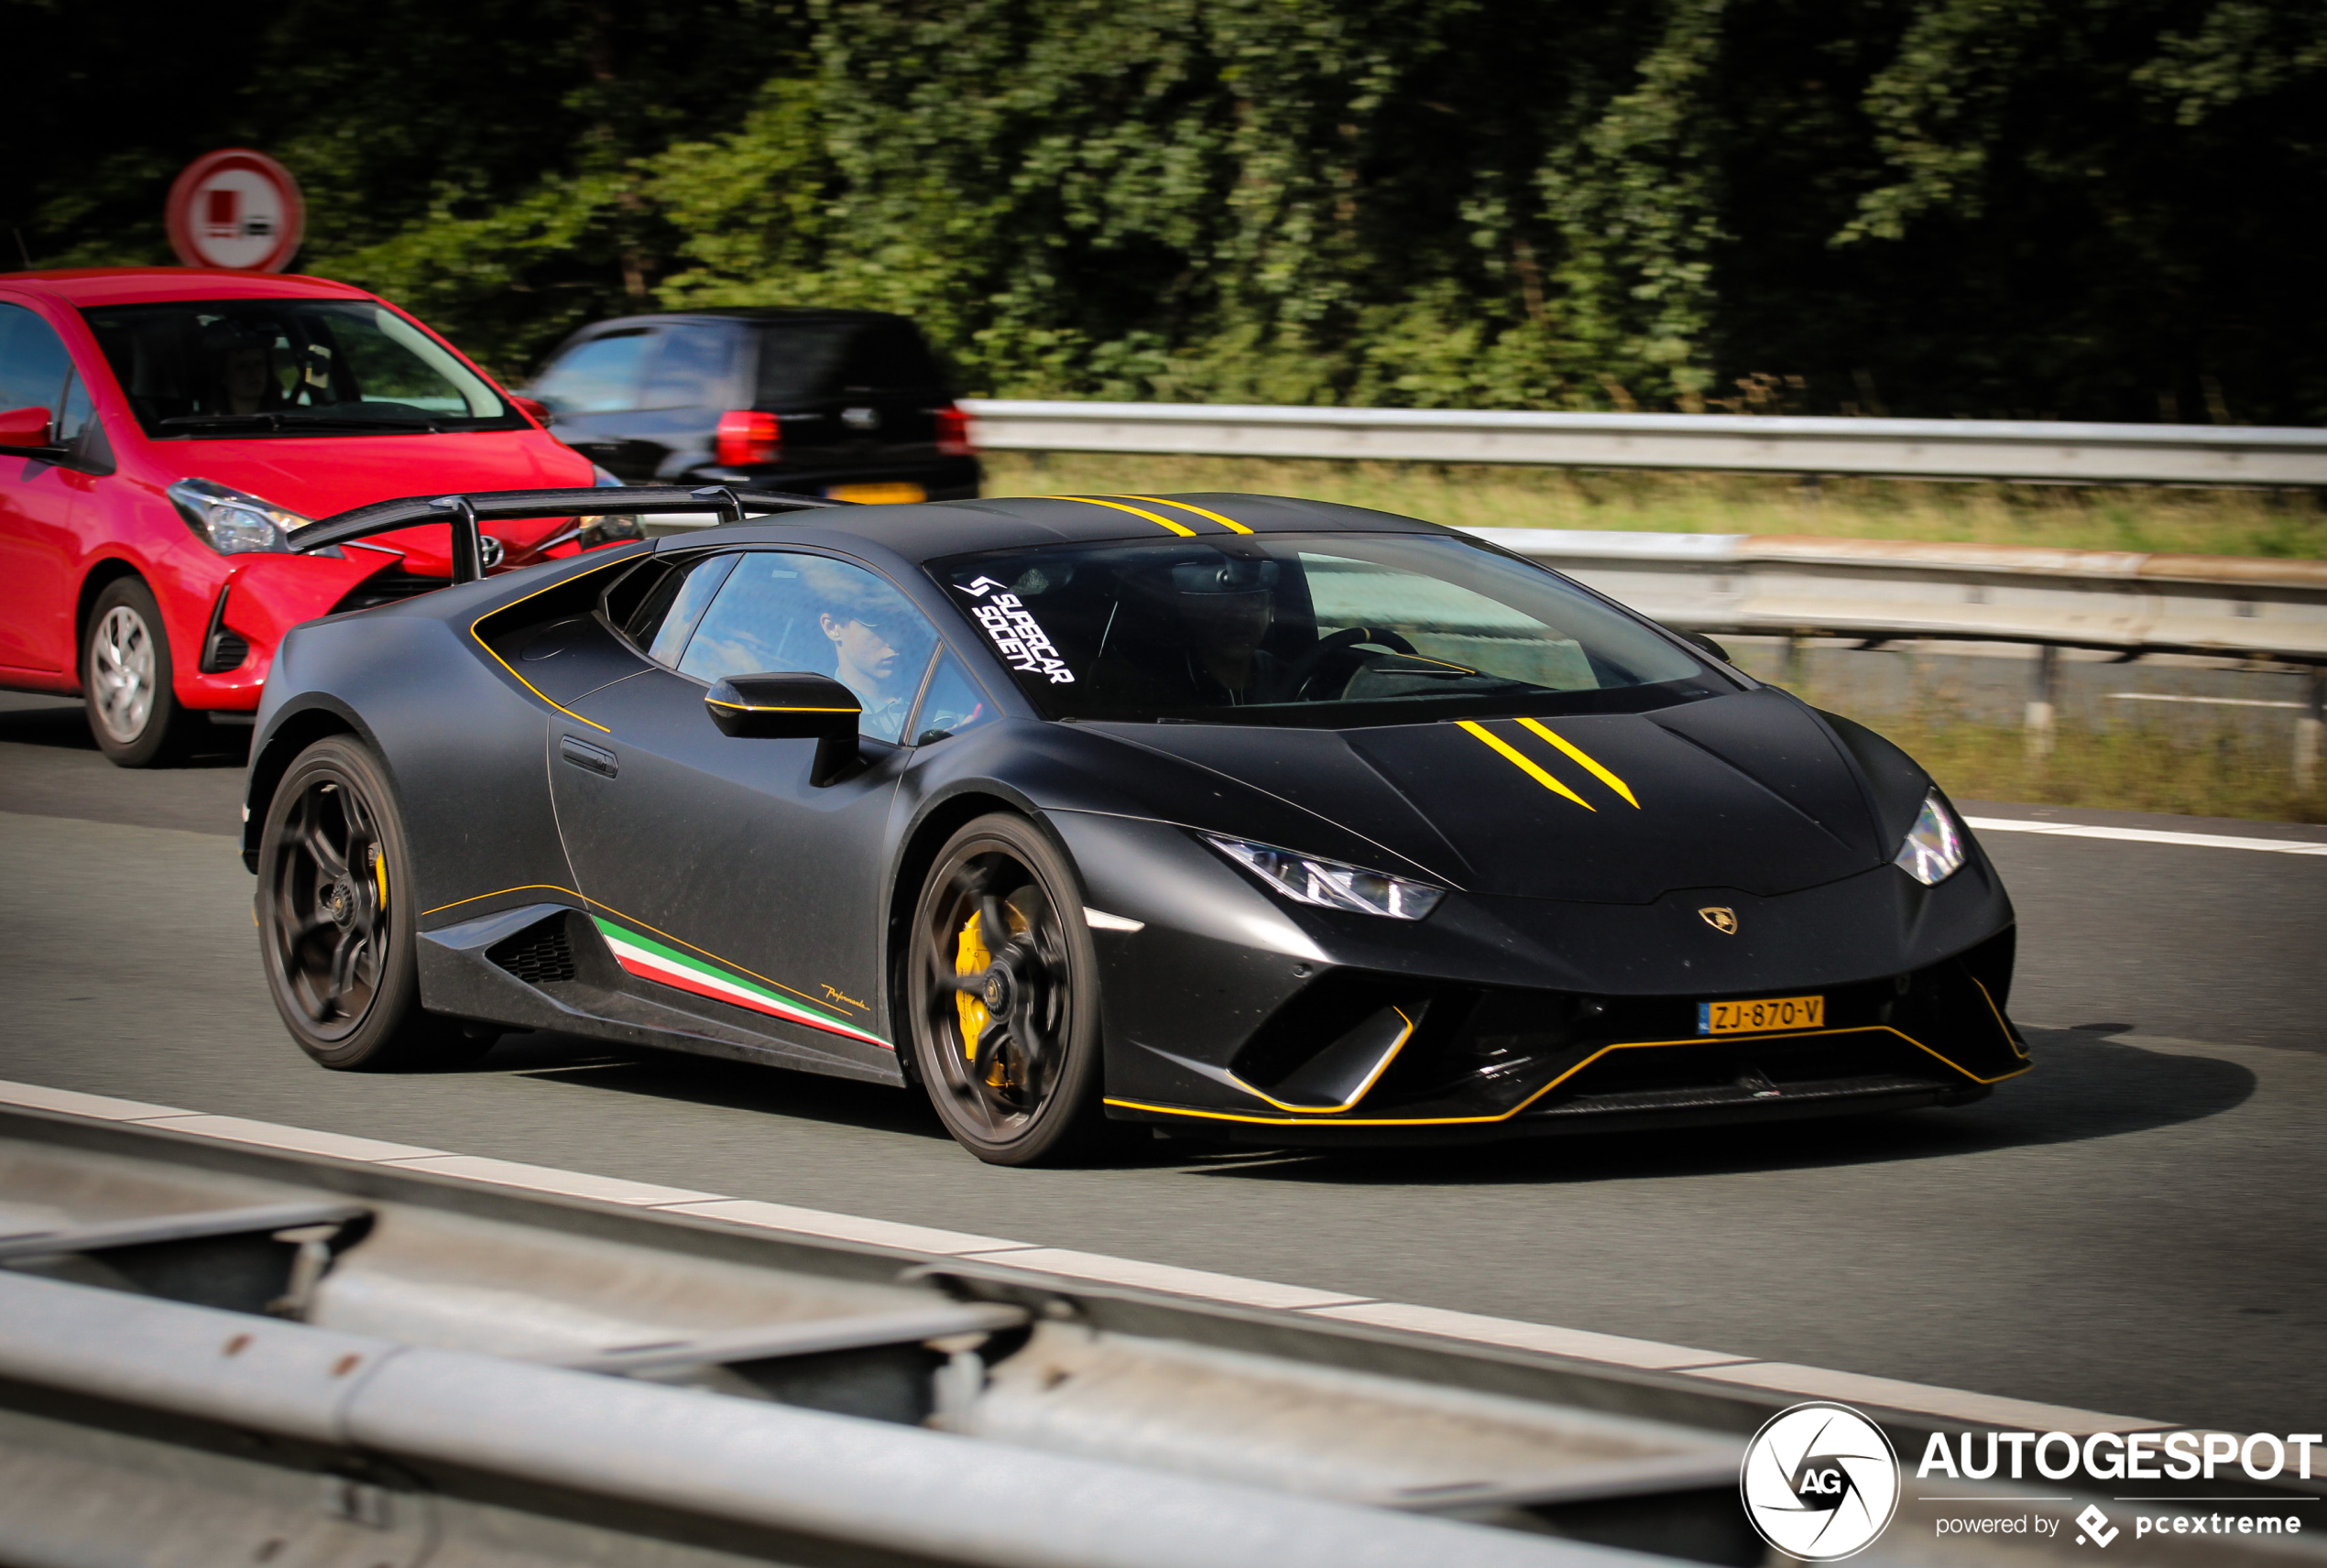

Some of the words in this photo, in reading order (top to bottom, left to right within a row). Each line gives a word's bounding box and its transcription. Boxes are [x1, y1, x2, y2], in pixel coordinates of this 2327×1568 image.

[971, 605, 1042, 673] SOCIETY
[990, 593, 1075, 684] SUPERCAR
[1715, 999, 1819, 1029] ZJ-870-V
